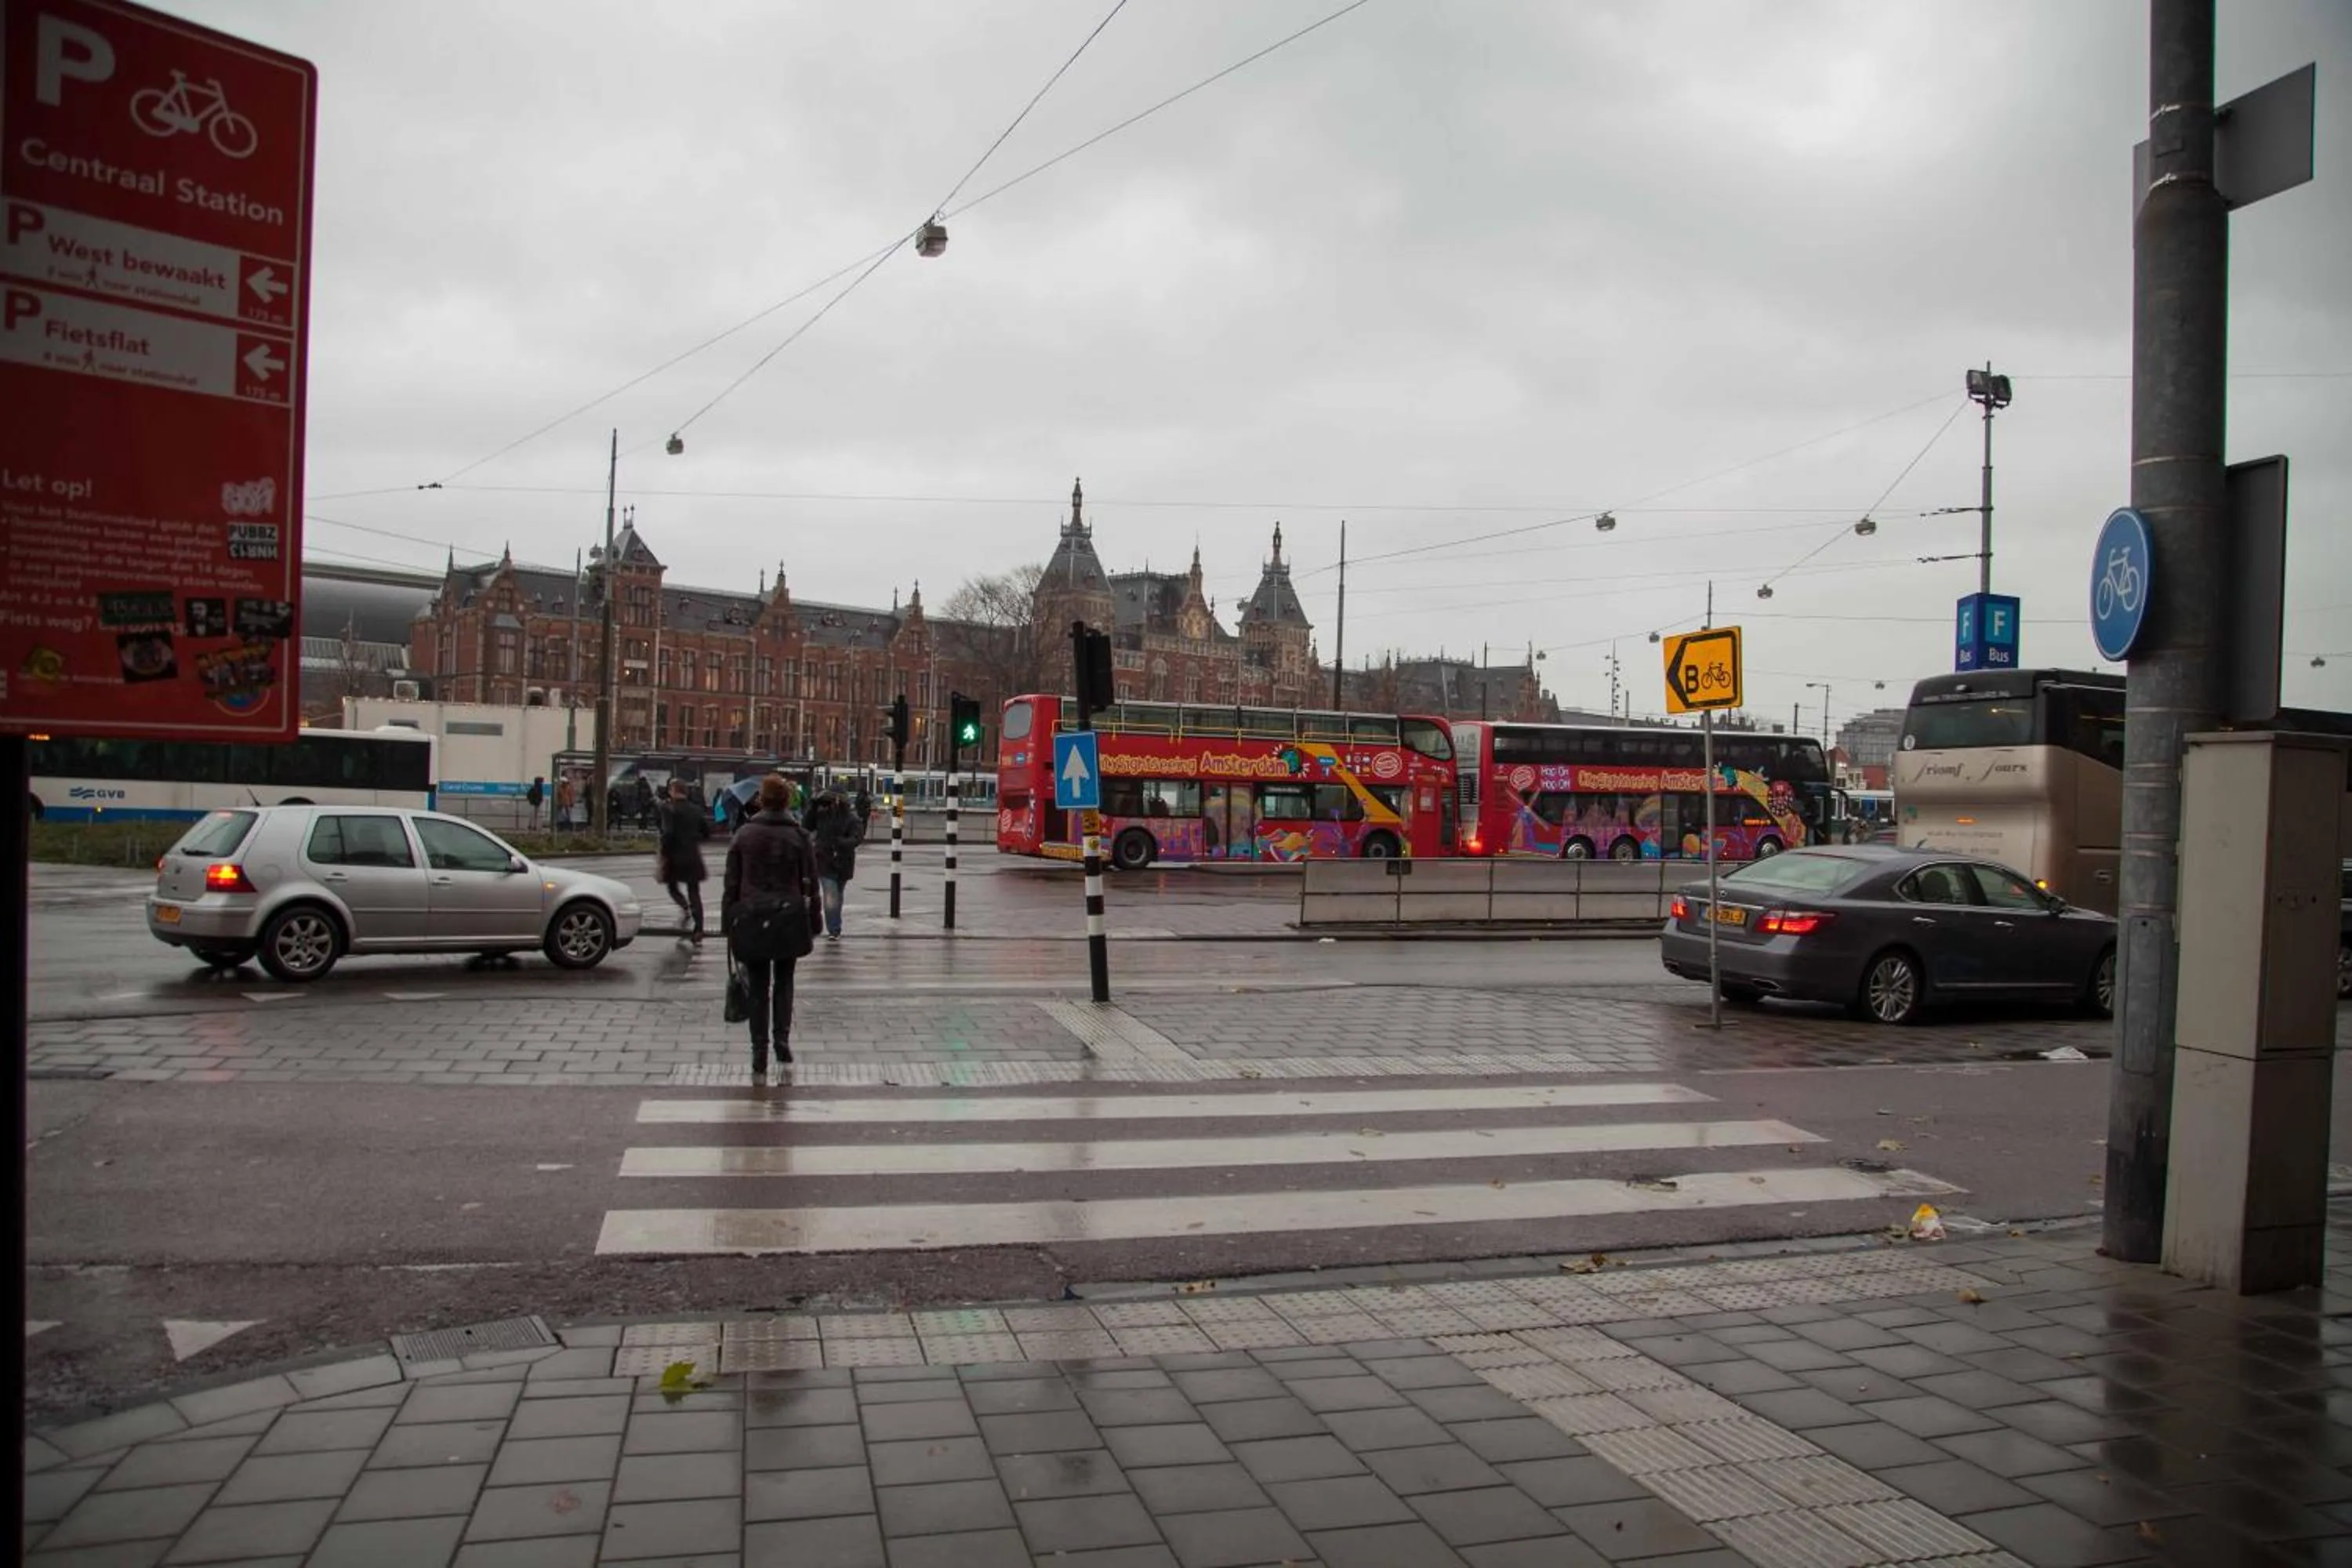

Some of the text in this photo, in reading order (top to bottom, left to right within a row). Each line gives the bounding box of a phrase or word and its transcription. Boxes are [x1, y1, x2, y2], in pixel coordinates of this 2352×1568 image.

[36, 12, 116, 107] P
[20, 137, 285, 225] Centraal Station
[7, 203, 46, 245] P
[48, 234, 114, 266] West
[123, 249, 227, 290] bewaakt
[4, 289, 42, 331] P
[45, 318, 151, 355] Fietsflat
[2, 468, 93, 502] Let op!
[1994, 610, 2006, 637] F
[1988, 647, 2009, 663] Bus
[1685, 664, 1700, 694] B
[1199, 750, 1291, 778] Amsterdam
[96, 789, 125, 799] GVB
